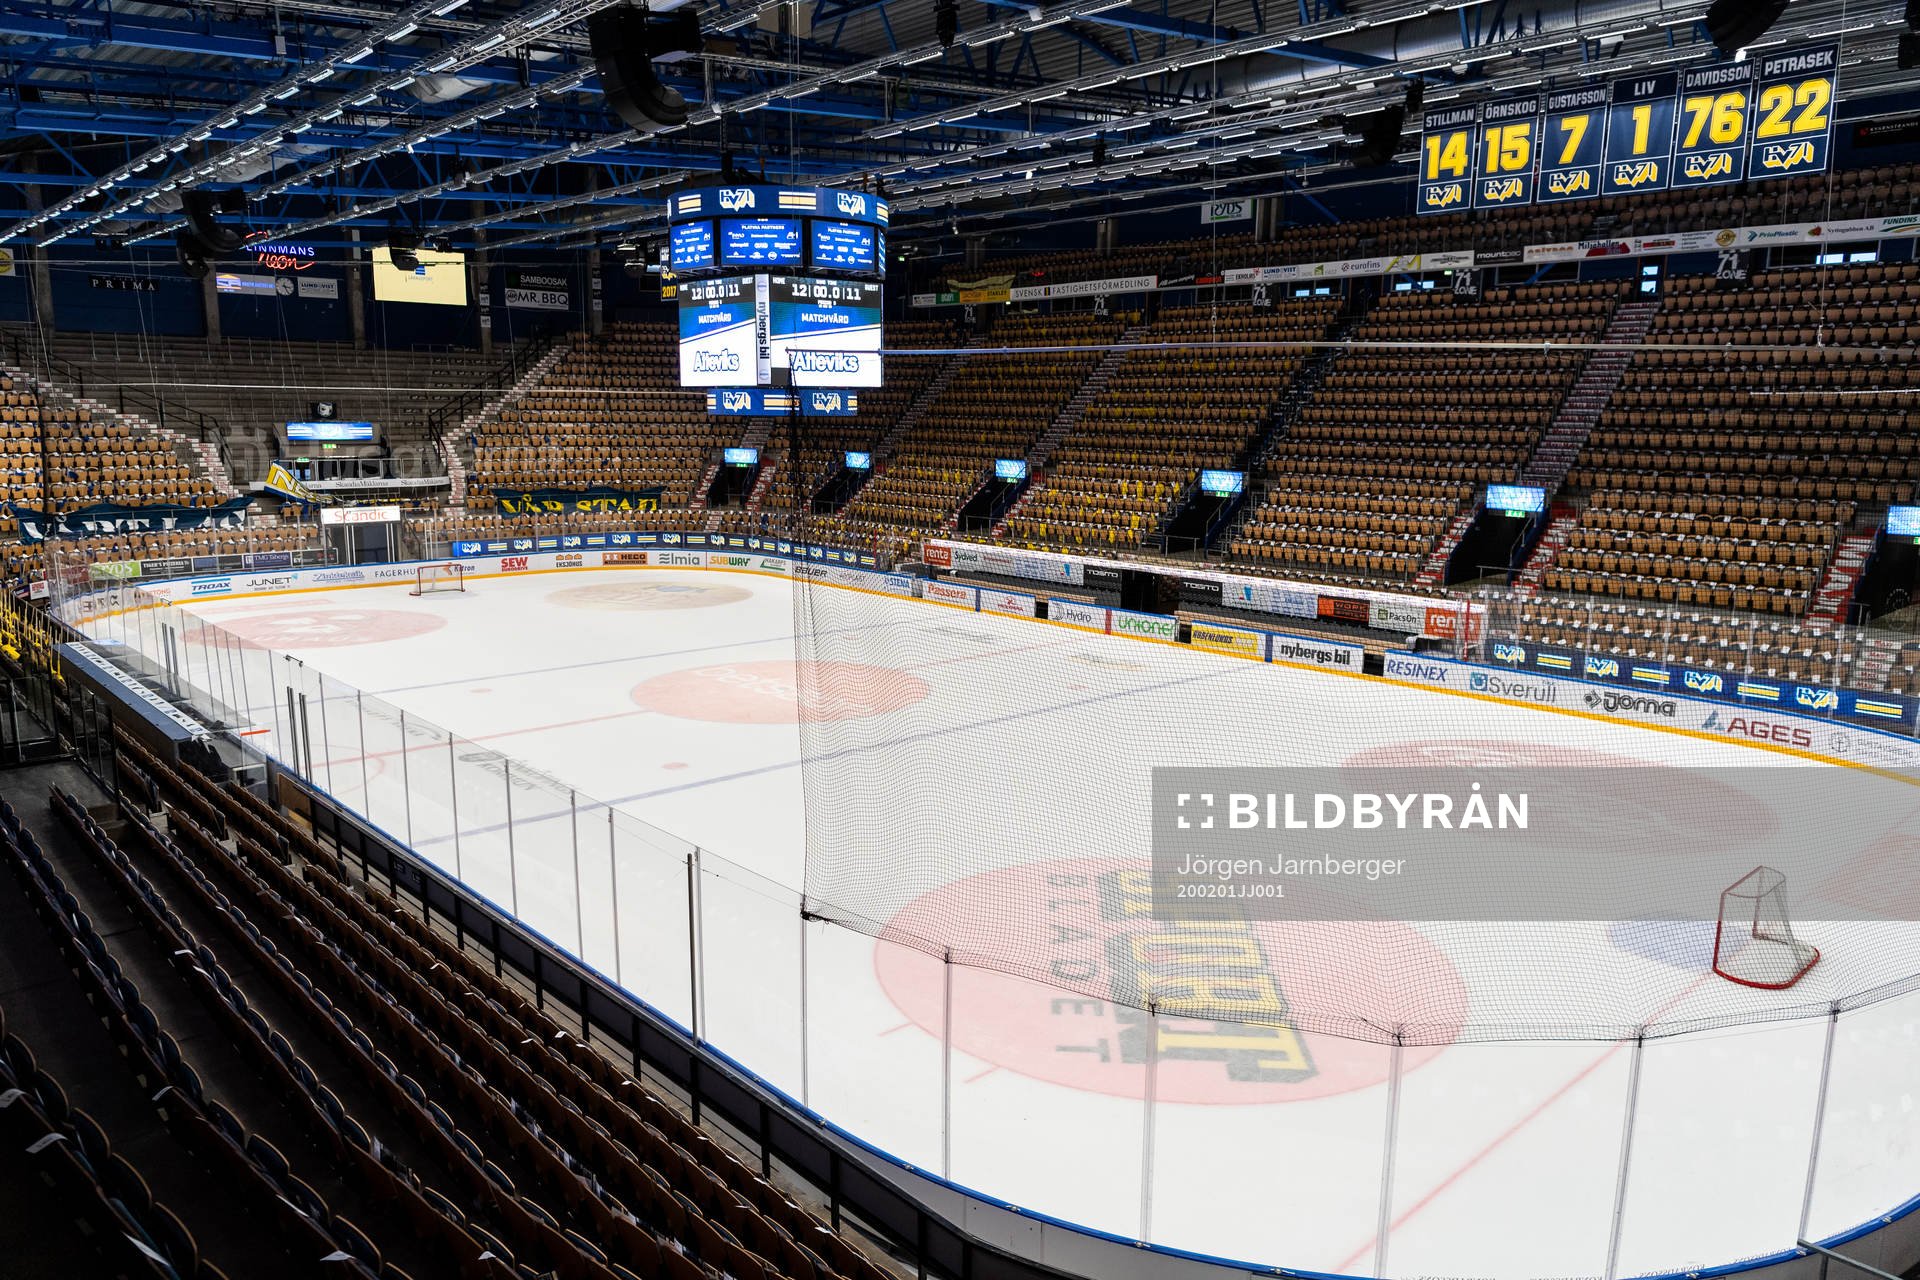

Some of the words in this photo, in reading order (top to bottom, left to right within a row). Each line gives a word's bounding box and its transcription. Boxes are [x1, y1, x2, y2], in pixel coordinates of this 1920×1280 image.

[1764, 50, 1834, 76] PETRASEK
[1686, 64, 1751, 88] DAVIDSSON
[1634, 80, 1656, 96] LIV
[1548, 88, 1606, 109] GUSTAFSSON
[1485, 100, 1537, 119] ÖRNSKOG
[1756, 77, 1831, 138] 22
[1426, 108, 1474, 128] STILLMAN
[1682, 91, 1746, 148] 76
[1632, 104, 1652, 154] 1
[1558, 114, 1589, 164] 7
[1426, 131, 1468, 180] 14
[1485, 122, 1531, 174] 15
[1882, 216, 1918, 225] FUNDINS
[1350, 261, 1380, 270] eurofins
[1716, 270, 1748, 280] ZONE
[92, 279, 155, 290] PRIMA
[662, 286, 677, 298] 2017
[1015, 288, 1042, 298] SVENSK
[1052, 278, 1150, 294] FASTIGHETSFÖRMEDLING
[518, 292, 540, 303] MR.
[542, 292, 568, 304] BBQ
[757, 302, 769, 344] nybergs
[802, 312, 848, 324] MATCHVÅRD
[760, 346, 770, 359] bil
[334, 509, 387, 522] Scandic
[500, 556, 528, 568] SEW
[710, 556, 750, 567] SUBWAY
[926, 548, 949, 560] renta
[954, 552, 978, 562] Sydved
[374, 568, 424, 578] FAGERHU
[192, 582, 230, 591] TROAX
[246, 577, 292, 587] JUNET
[1066, 610, 1092, 623] Hydro
[1280, 643, 1332, 664] nybergs
[1334, 648, 1350, 665] bil
[1386, 660, 1448, 682] RESINEX
[1488, 677, 1556, 703] Sverull
[1727, 718, 1812, 748] AGES
